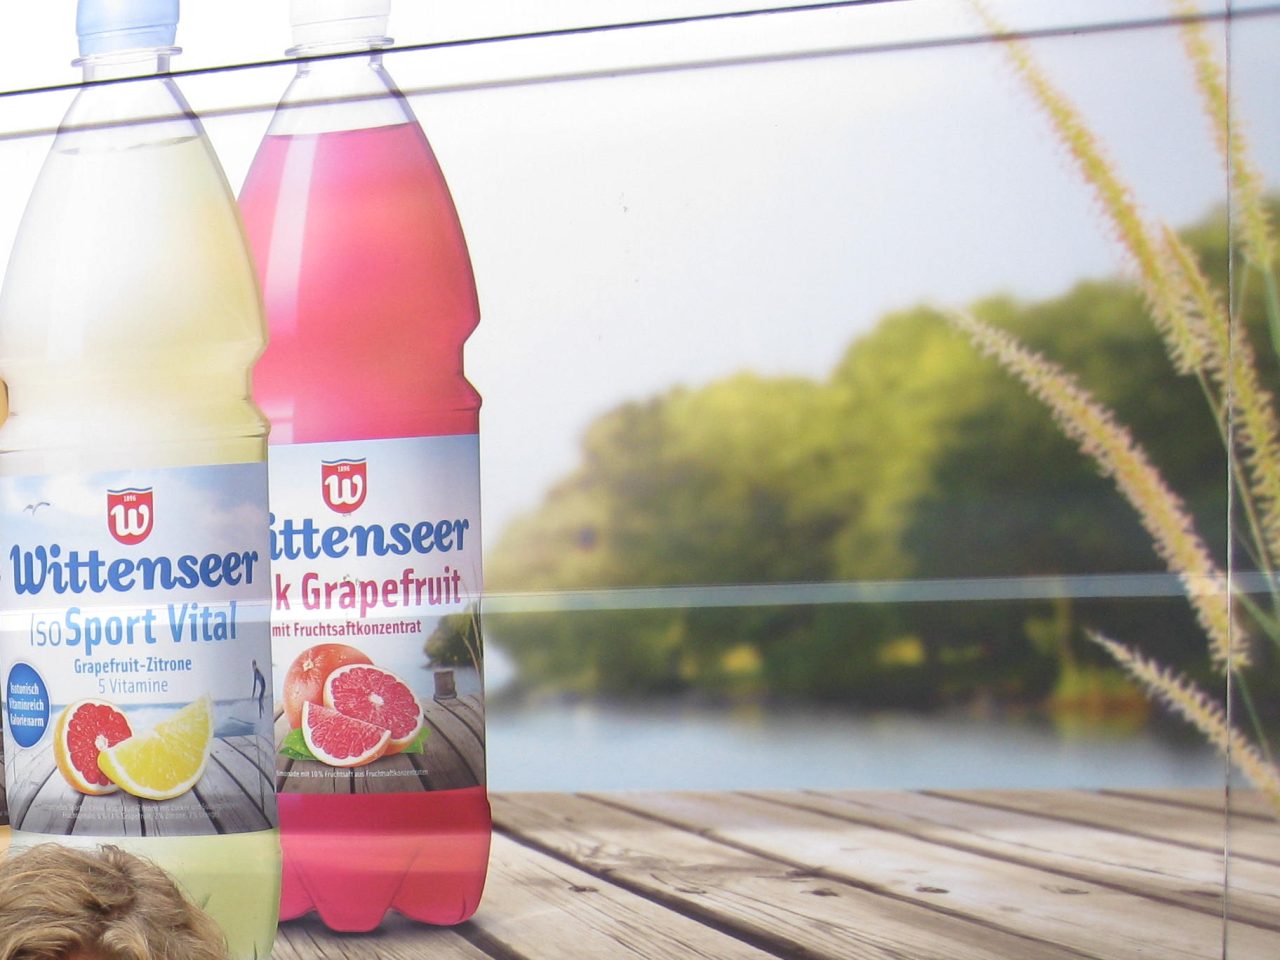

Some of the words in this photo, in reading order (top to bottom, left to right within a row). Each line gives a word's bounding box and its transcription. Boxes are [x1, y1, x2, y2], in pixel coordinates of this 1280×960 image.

[10, 543, 259, 596] Wittenseer
[301, 565, 462, 618] Grapefruit
[167, 600, 238, 643] Vital
[272, 622, 291, 637] mit
[293, 619, 422, 638] Fruchtsaftkonzentrat
[73, 656, 193, 677] Grapefruit-Zitrone
[98, 679, 105, 694] 5
[109, 678, 169, 694] Vitamine
